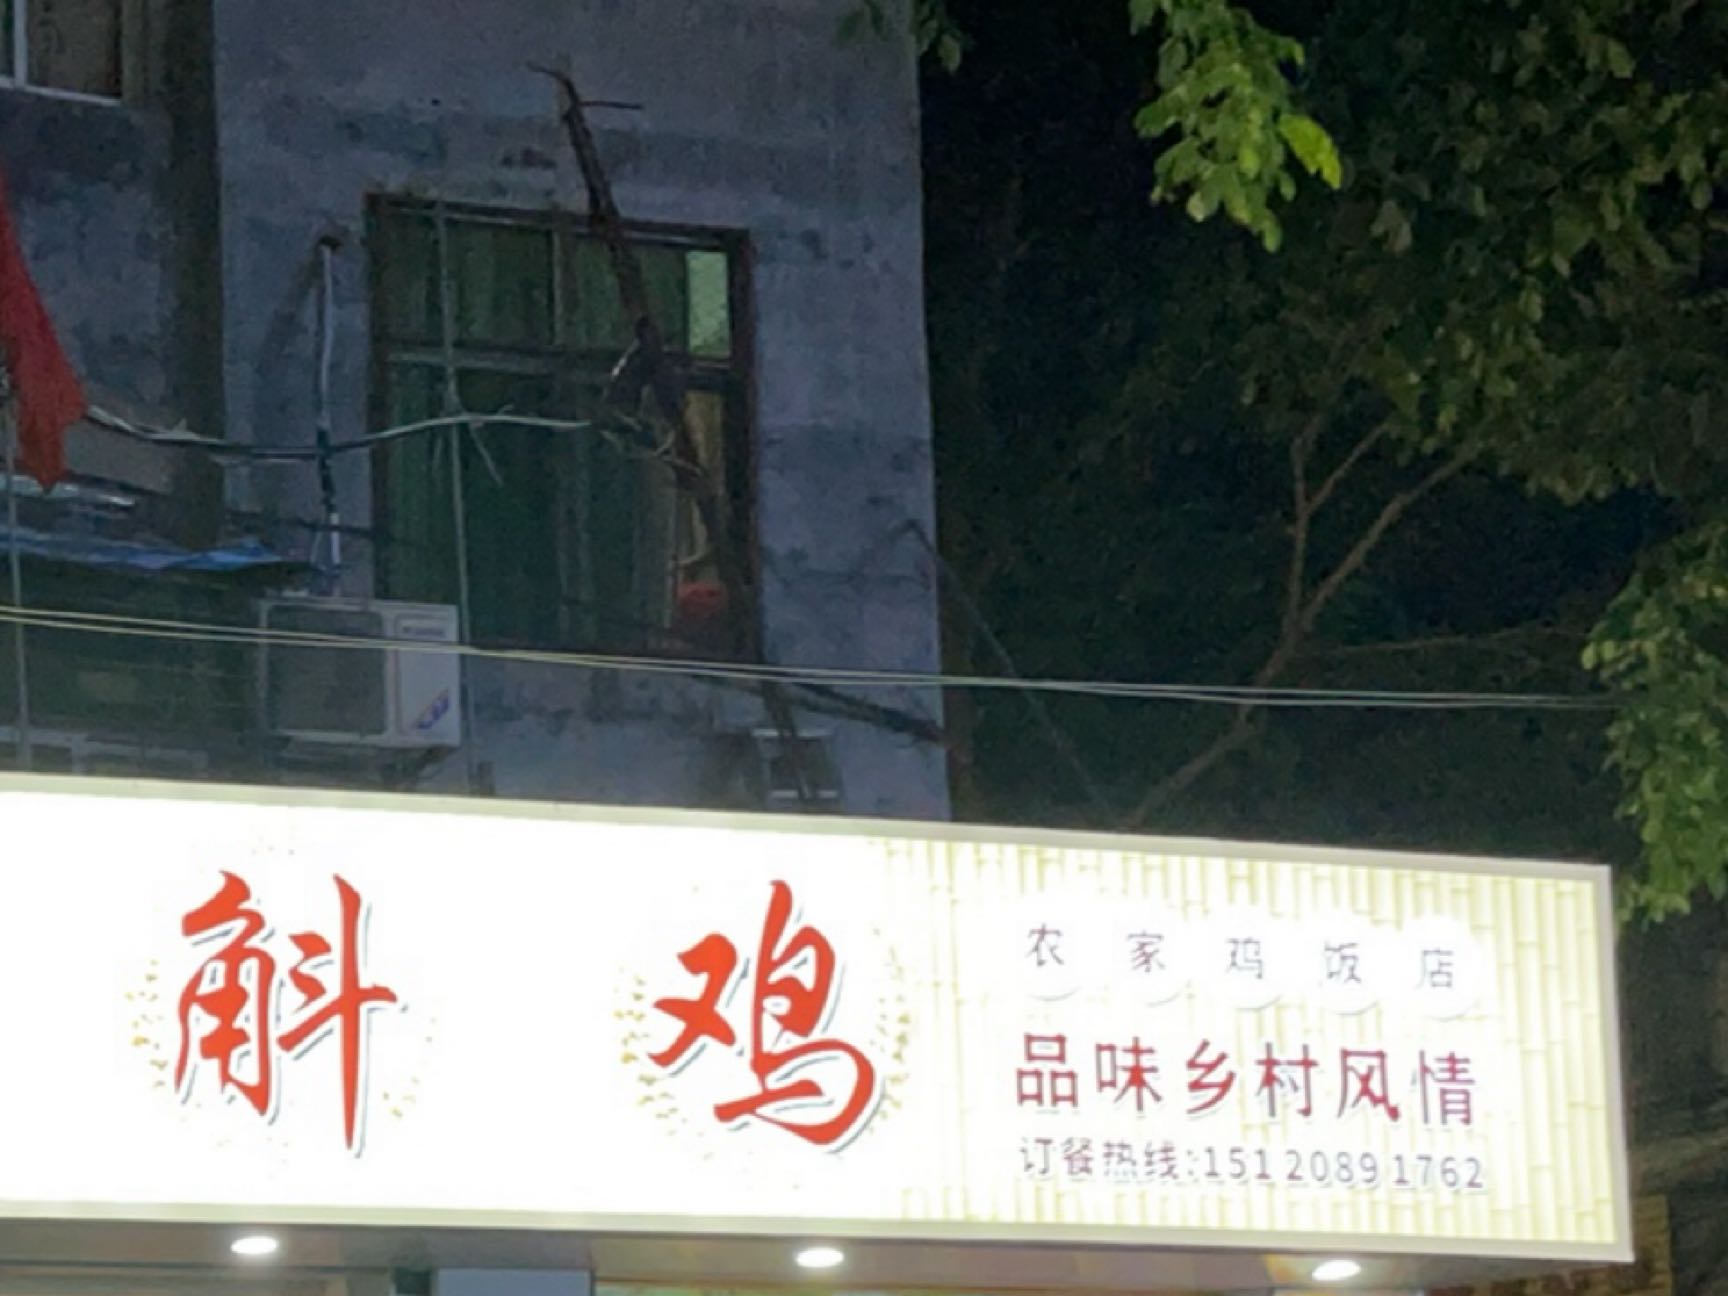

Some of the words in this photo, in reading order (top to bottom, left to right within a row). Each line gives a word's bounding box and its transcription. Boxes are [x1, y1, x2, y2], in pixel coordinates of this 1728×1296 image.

[1025, 923, 1456, 990] 农家鸡饭店
[1016, 1033, 1475, 1125] 品味乡村风情
